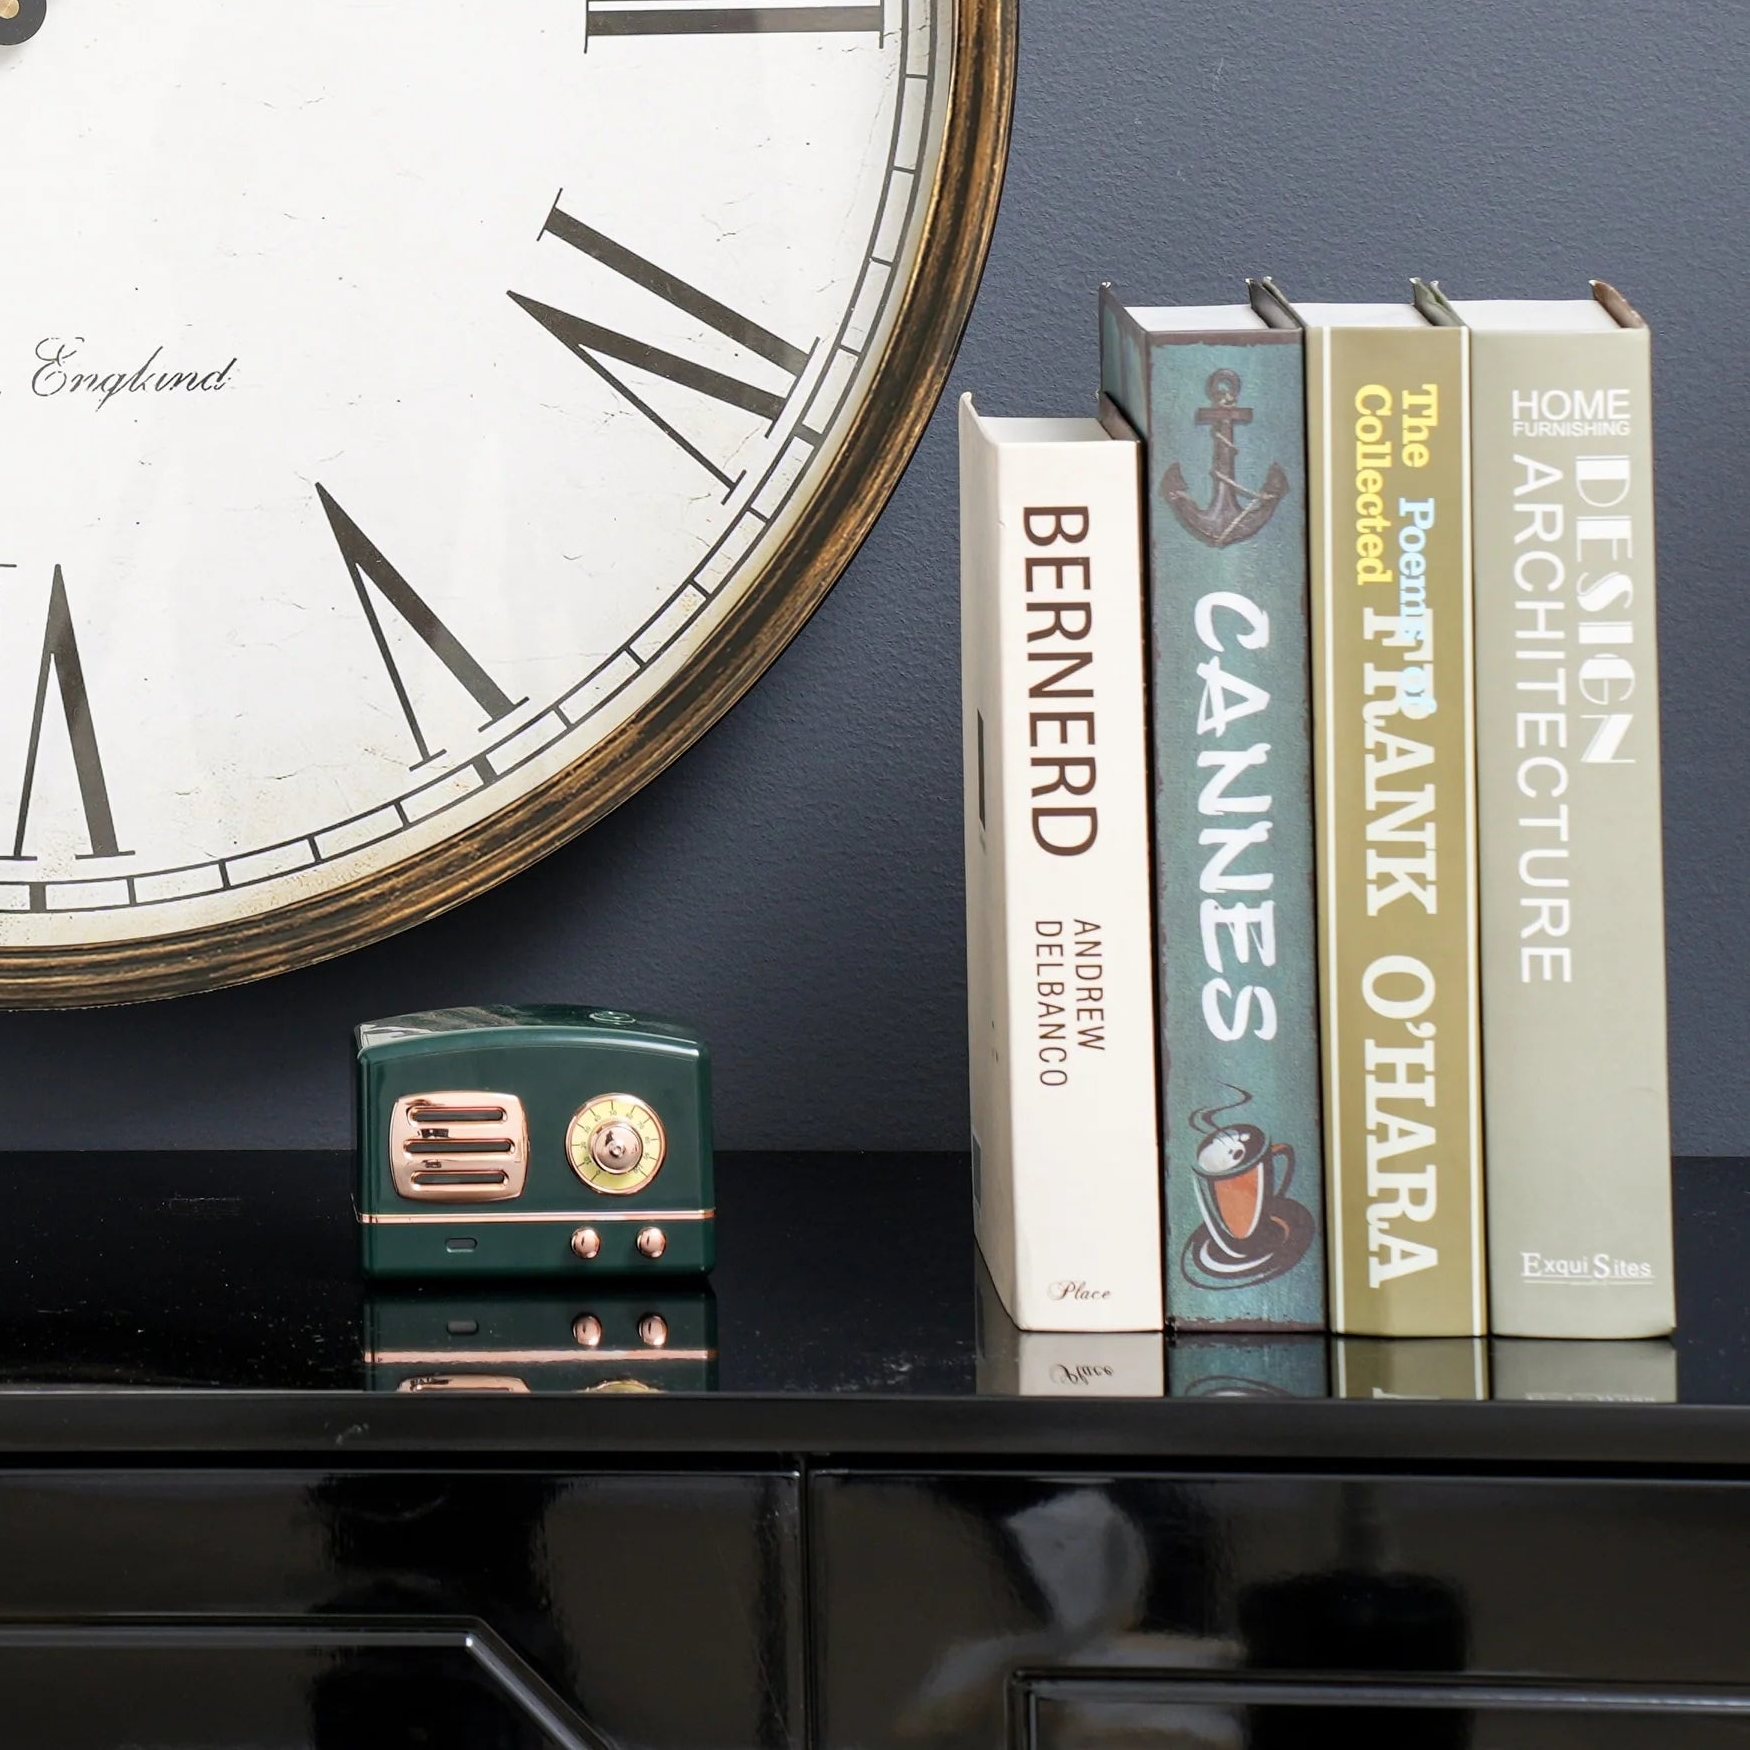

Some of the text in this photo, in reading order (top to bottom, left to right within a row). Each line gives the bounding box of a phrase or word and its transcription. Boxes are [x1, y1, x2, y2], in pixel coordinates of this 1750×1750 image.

[1354, 383, 1393, 586] Collected
[1401, 383, 1438, 468] The
[1512, 388, 1632, 420] HOME
[1512, 421, 1632, 438] FURNISHING
[1399, 497, 1434, 641] Poems
[1574, 454, 1637, 764] DESIGN
[1023, 505, 1099, 858] BERNERD
[1512, 453, 1573, 984] ARCHITECTURE
[1194, 591, 1278, 1042] CANNES
[1035, 920, 1068, 1087] DELBANCO
[1073, 918, 1106, 1051] ANDREW
[1361, 607, 1439, 1290] FRANK O'HARA
[1049, 1280, 1111, 1301] Place
